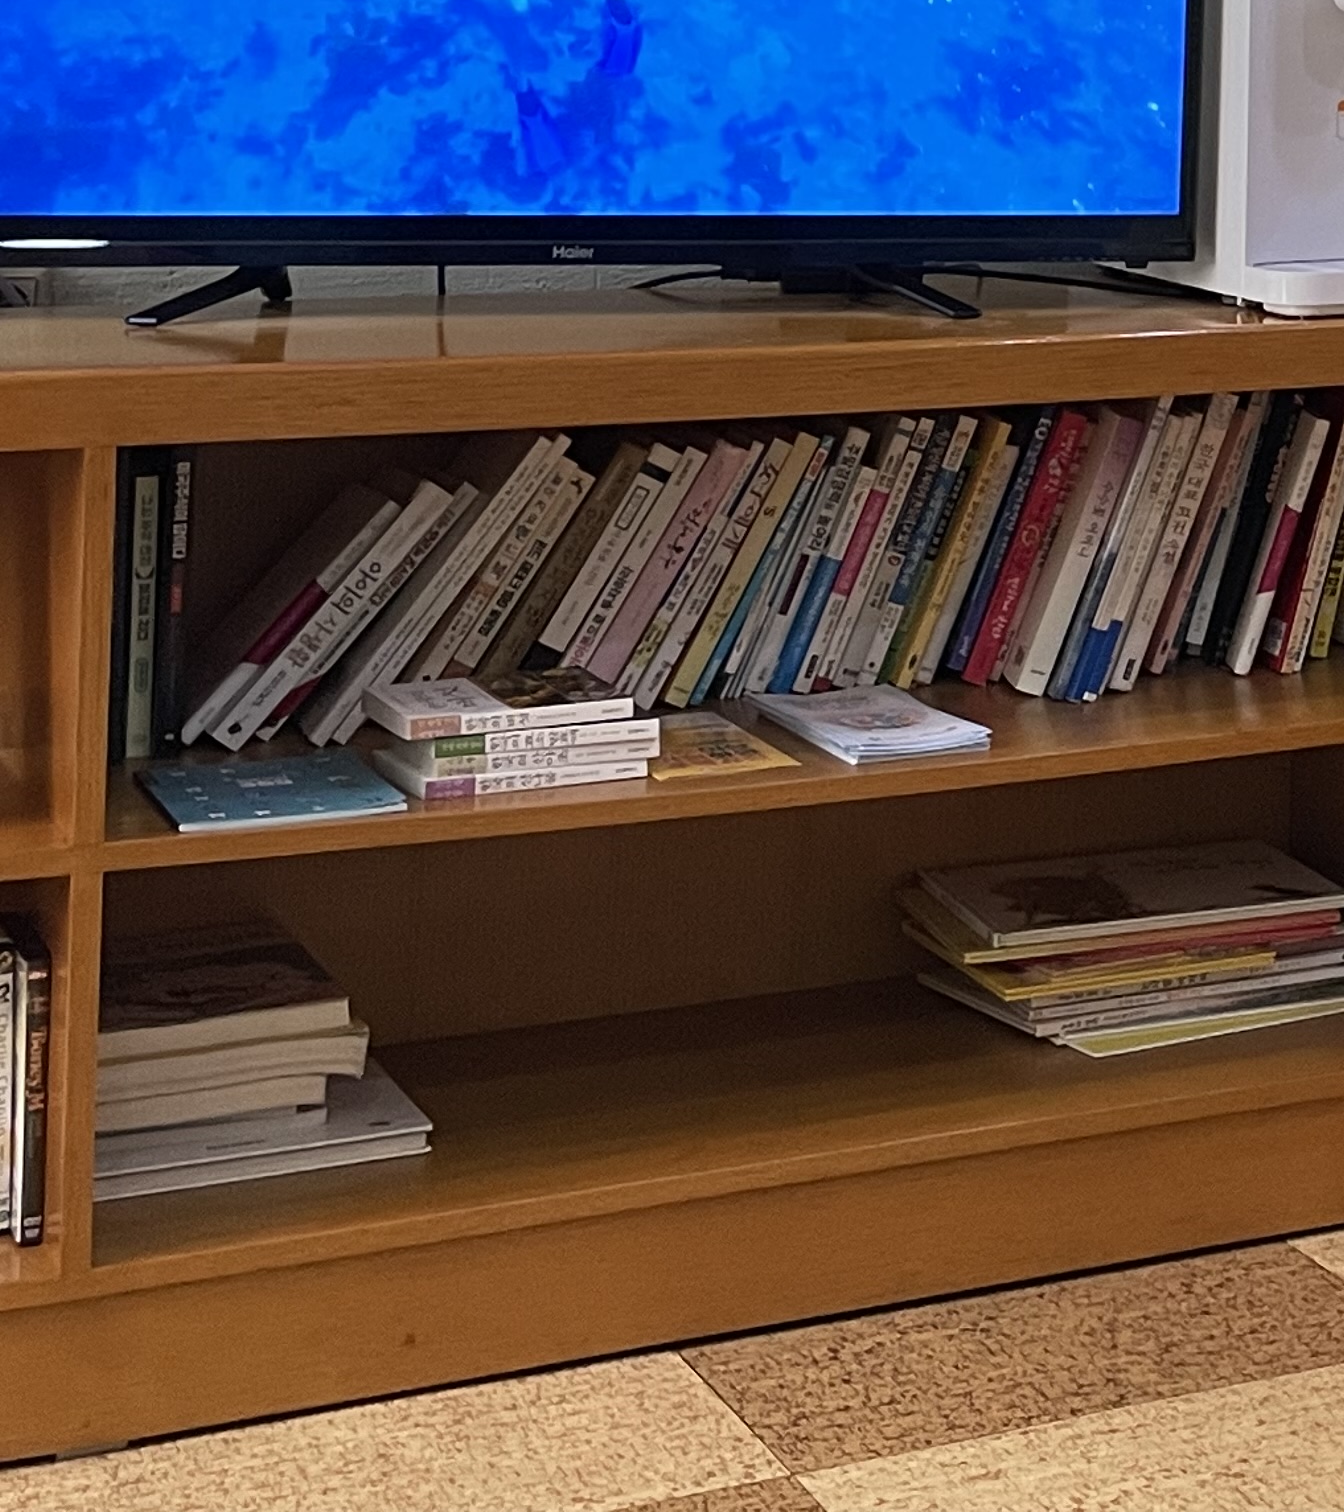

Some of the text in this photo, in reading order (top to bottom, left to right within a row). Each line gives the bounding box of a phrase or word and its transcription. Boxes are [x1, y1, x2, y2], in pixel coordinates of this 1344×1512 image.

[552, 245, 594, 259] Haier
[282, 555, 386, 674] 아이의 사생활
